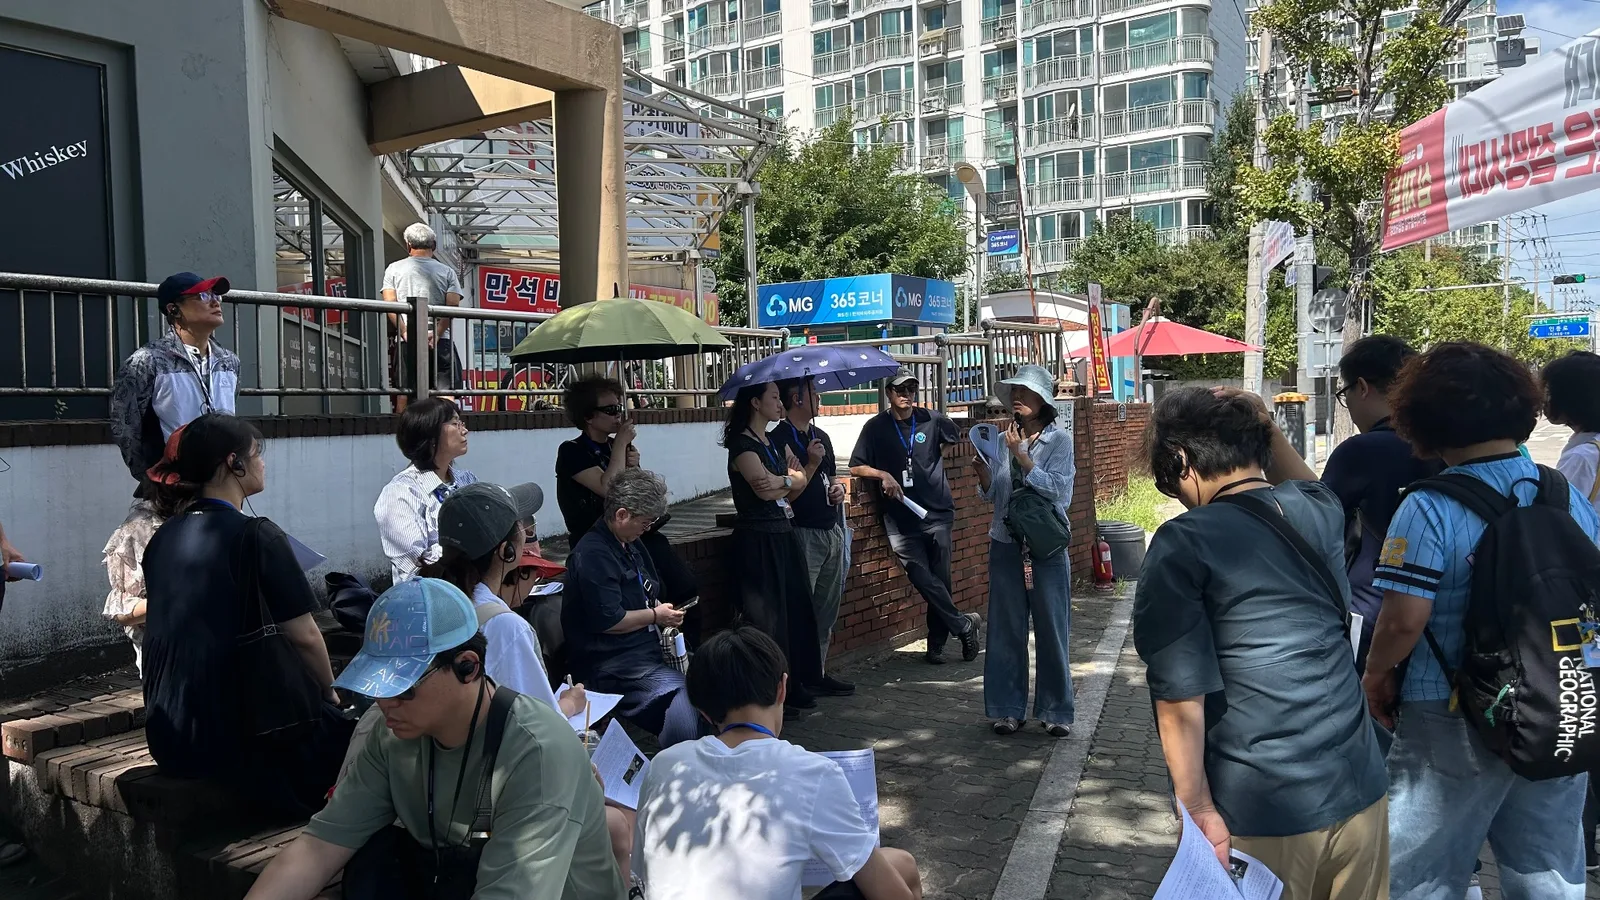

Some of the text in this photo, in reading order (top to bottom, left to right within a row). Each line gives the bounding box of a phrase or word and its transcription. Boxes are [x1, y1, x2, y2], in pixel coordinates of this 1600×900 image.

[0, 139, 87, 180] Whiskey
[789, 296, 814, 313] MG
[908, 292, 922, 307] MG
[1554, 656, 1579, 758] GEOGRAPHIC
[1573, 656, 1597, 739] NATIONAL
